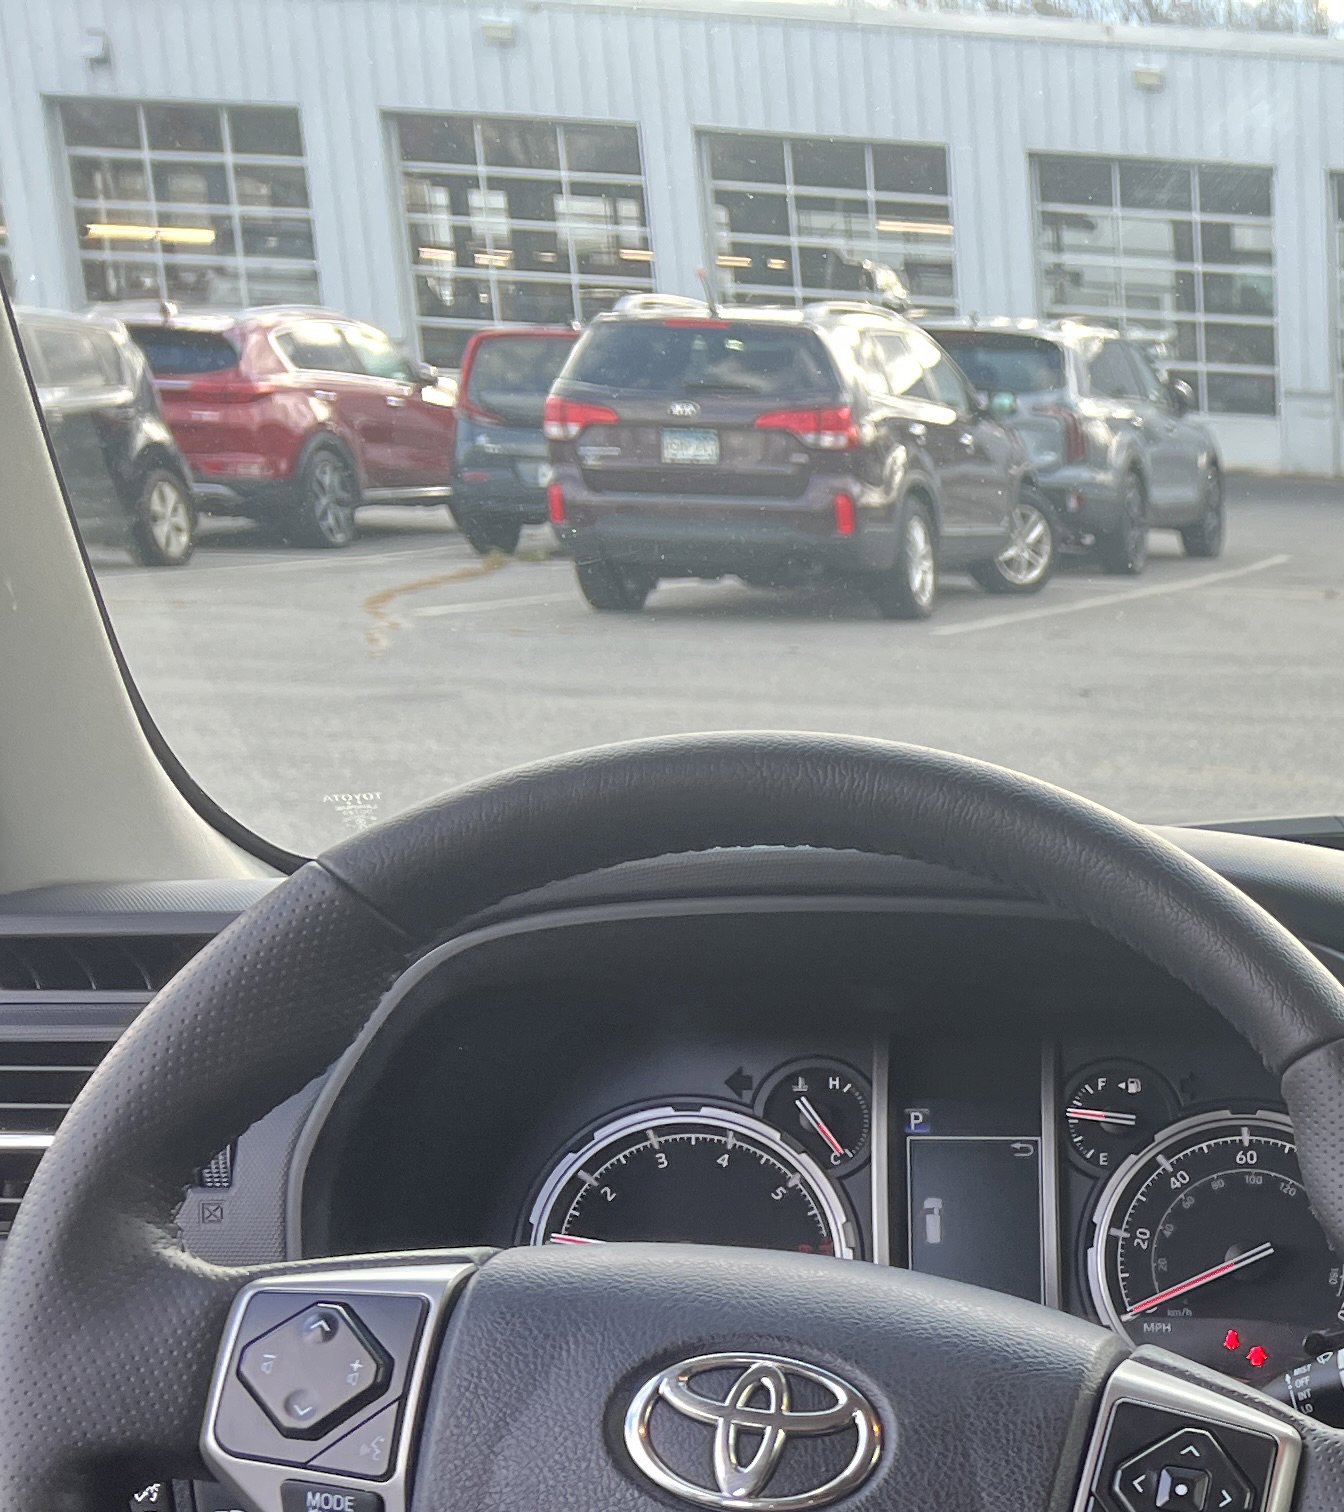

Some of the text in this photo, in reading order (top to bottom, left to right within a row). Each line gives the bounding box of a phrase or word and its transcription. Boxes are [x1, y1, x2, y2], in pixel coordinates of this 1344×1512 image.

[828, 1077, 841, 1090] H
[1097, 1078, 1107, 1091] F
[910, 1112, 924, 1129] P
[655, 1152, 669, 1169] 3
[716, 1153, 731, 1169] 4
[829, 1153, 842, 1166] C
[1098, 1152, 1108, 1166] E
[1235, 1149, 1258, 1165] 60
[1168, 1169, 1191, 1191] 40
[1210, 1179, 1226, 1191] 80
[1244, 1175, 1263, 1186] 100
[600, 1186, 617, 1202] 2
[771, 1186, 788, 1202] 5
[1279, 1182, 1297, 1197] 120
[1181, 1195, 1196, 1209] 60
[1133, 1226, 1151, 1250] 20
[1143, 1322, 1172, 1334] MPH
[1294, 1376, 1311, 1389] OFF
[1297, 1389, 1312, 1402] INT
[306, 1490, 355, 1512] MODE
